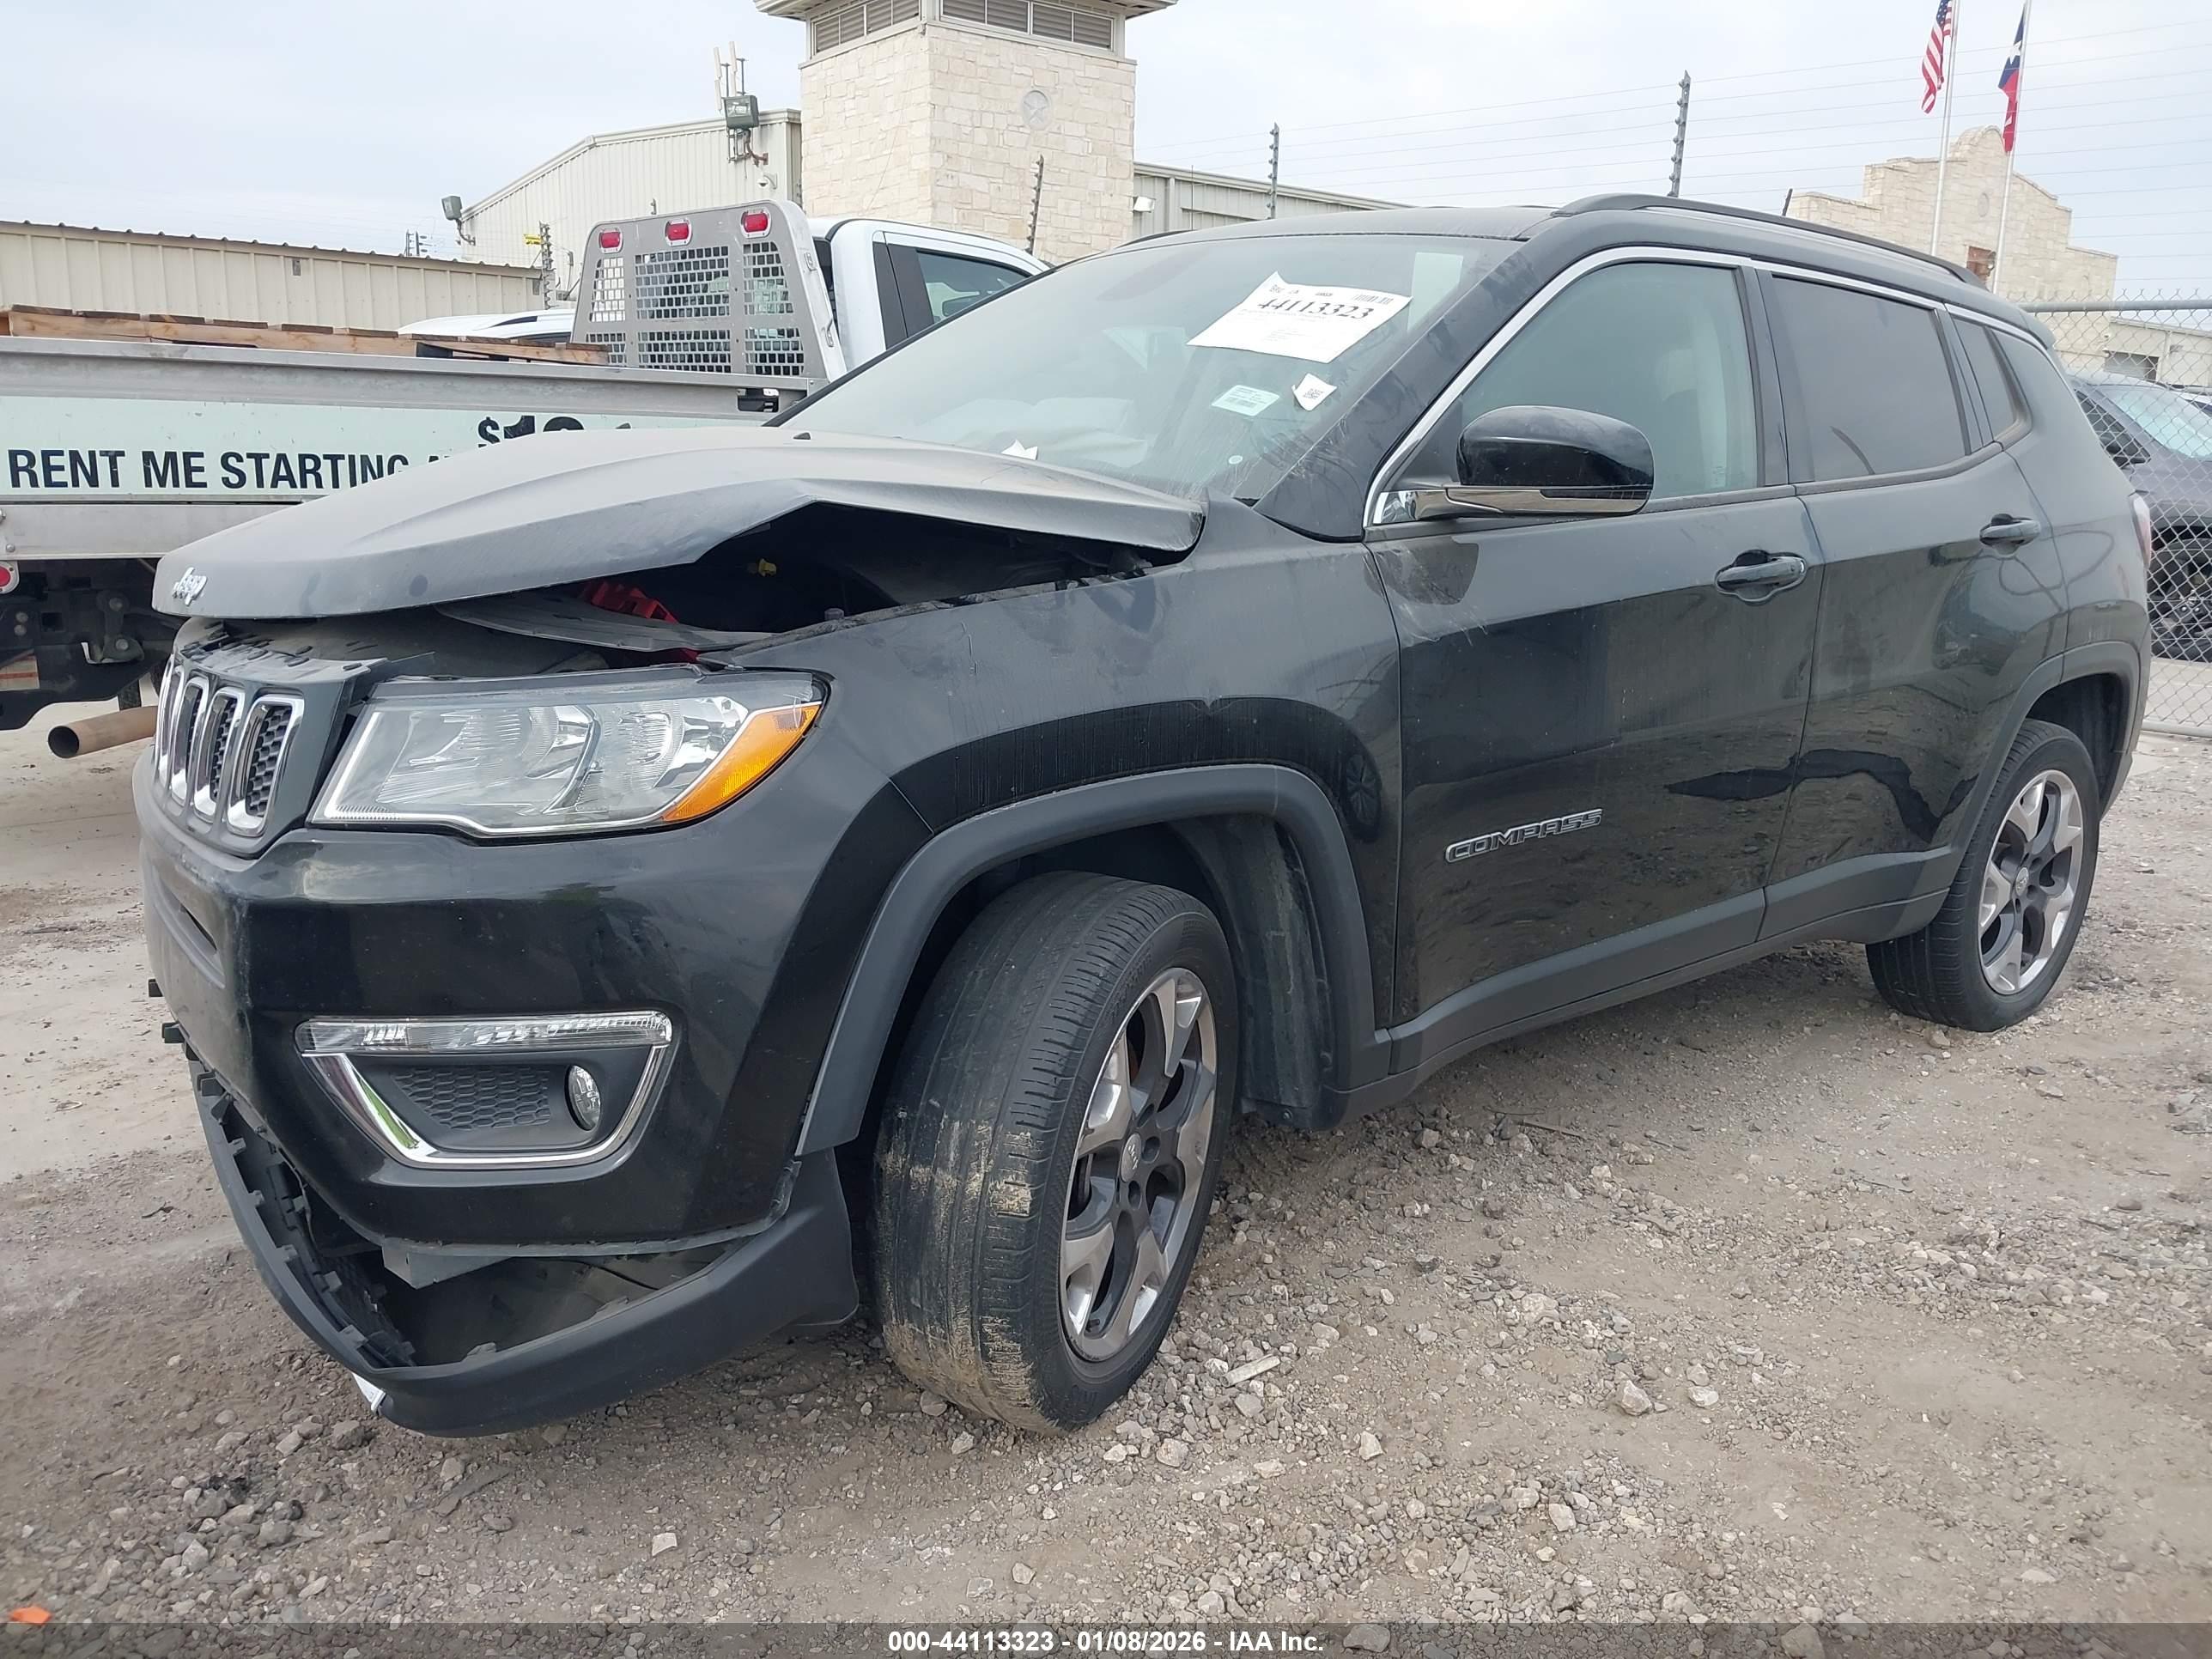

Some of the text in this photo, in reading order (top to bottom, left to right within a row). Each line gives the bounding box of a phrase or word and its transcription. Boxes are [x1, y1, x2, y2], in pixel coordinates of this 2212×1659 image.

[1257, 298, 1375, 319] 44113323
[7, 449, 126, 489] RENT
[141, 450, 208, 489] ME
[1445, 808, 1603, 863] COMPASS
